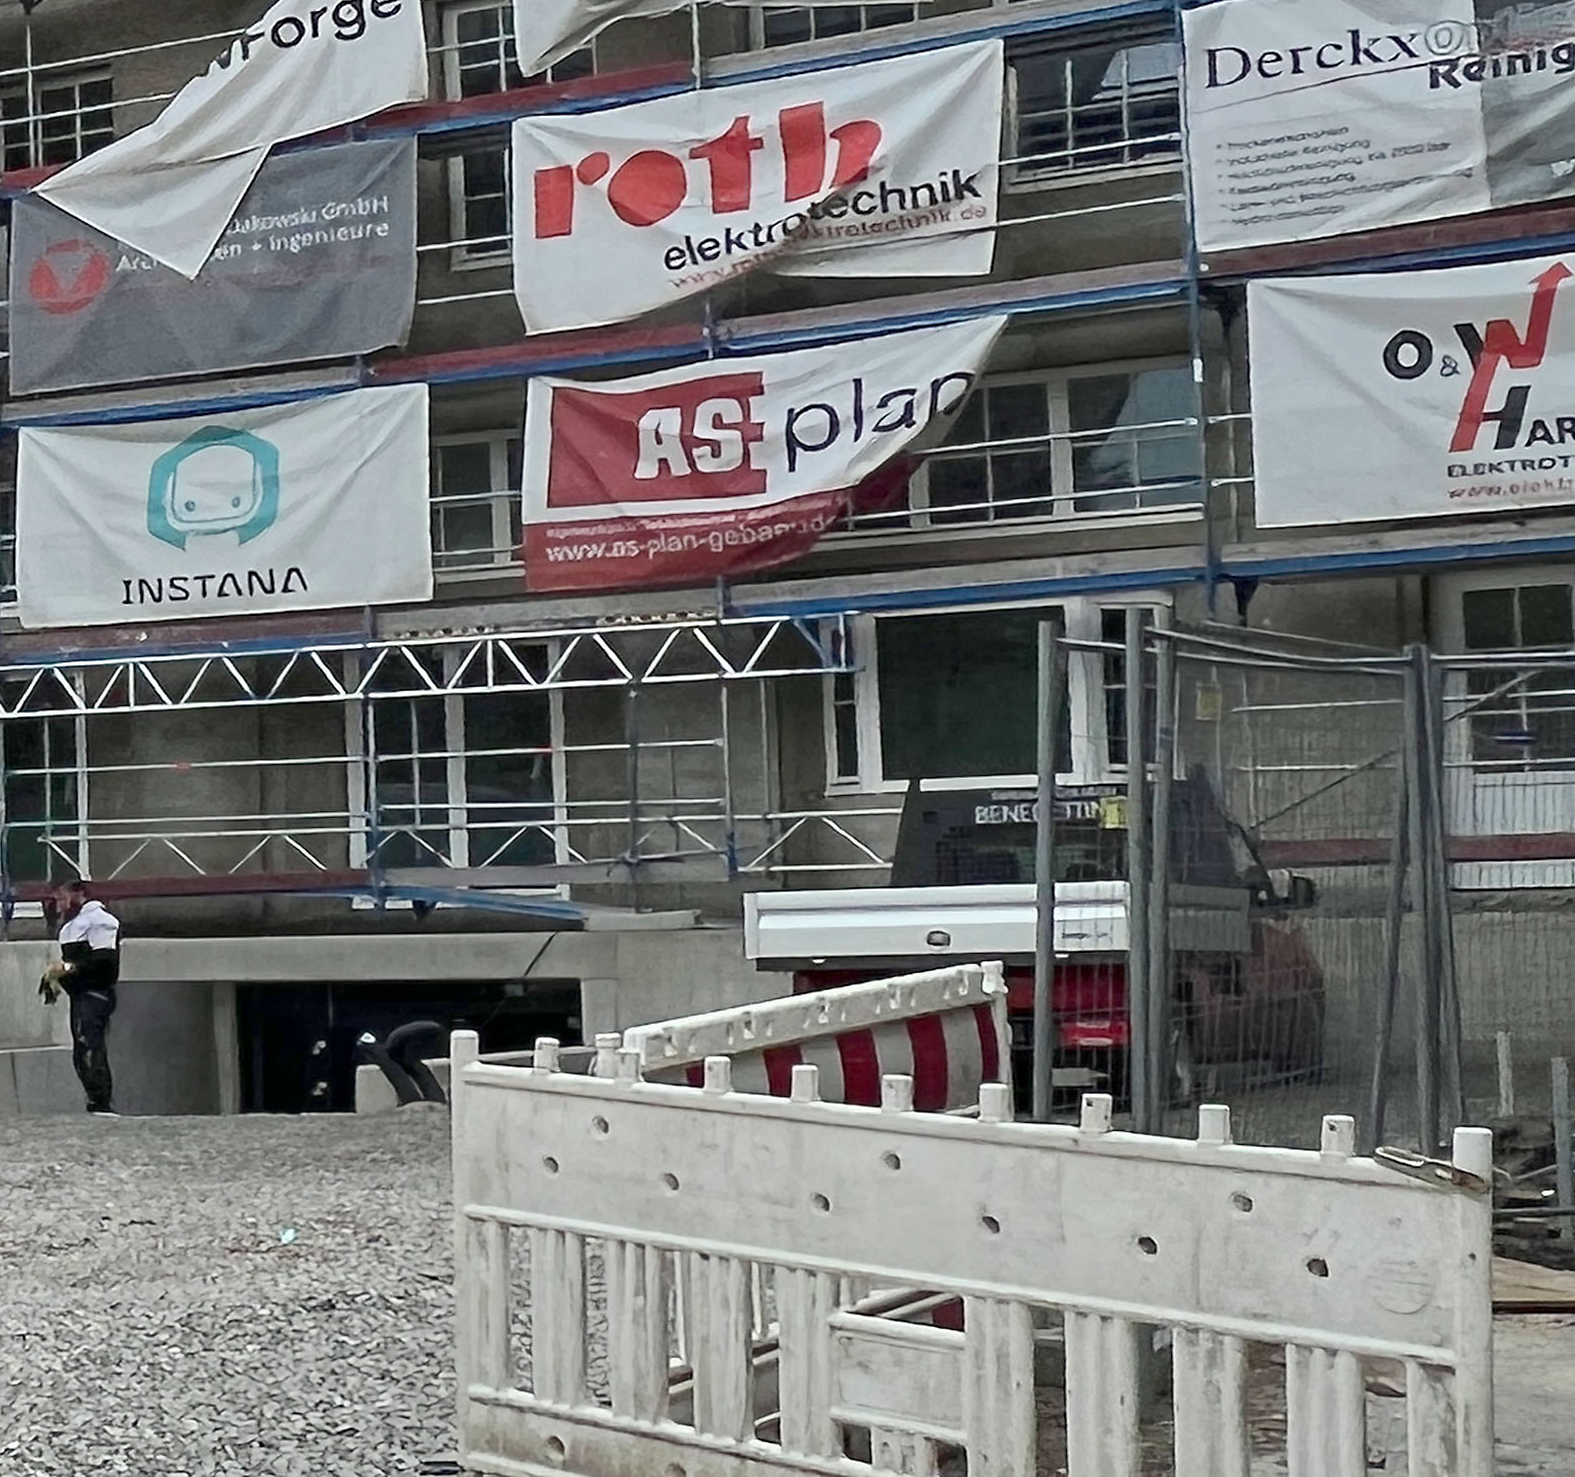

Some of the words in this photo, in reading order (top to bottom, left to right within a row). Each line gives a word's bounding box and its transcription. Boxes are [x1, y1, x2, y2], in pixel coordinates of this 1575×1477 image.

[1204, 28, 1422, 90] Derckx
[534, 100, 883, 240] roth
[663, 168, 982, 272] elektrotechnik
[785, 371, 977, 474] plan
[121, 566, 310, 606] INSTANA
